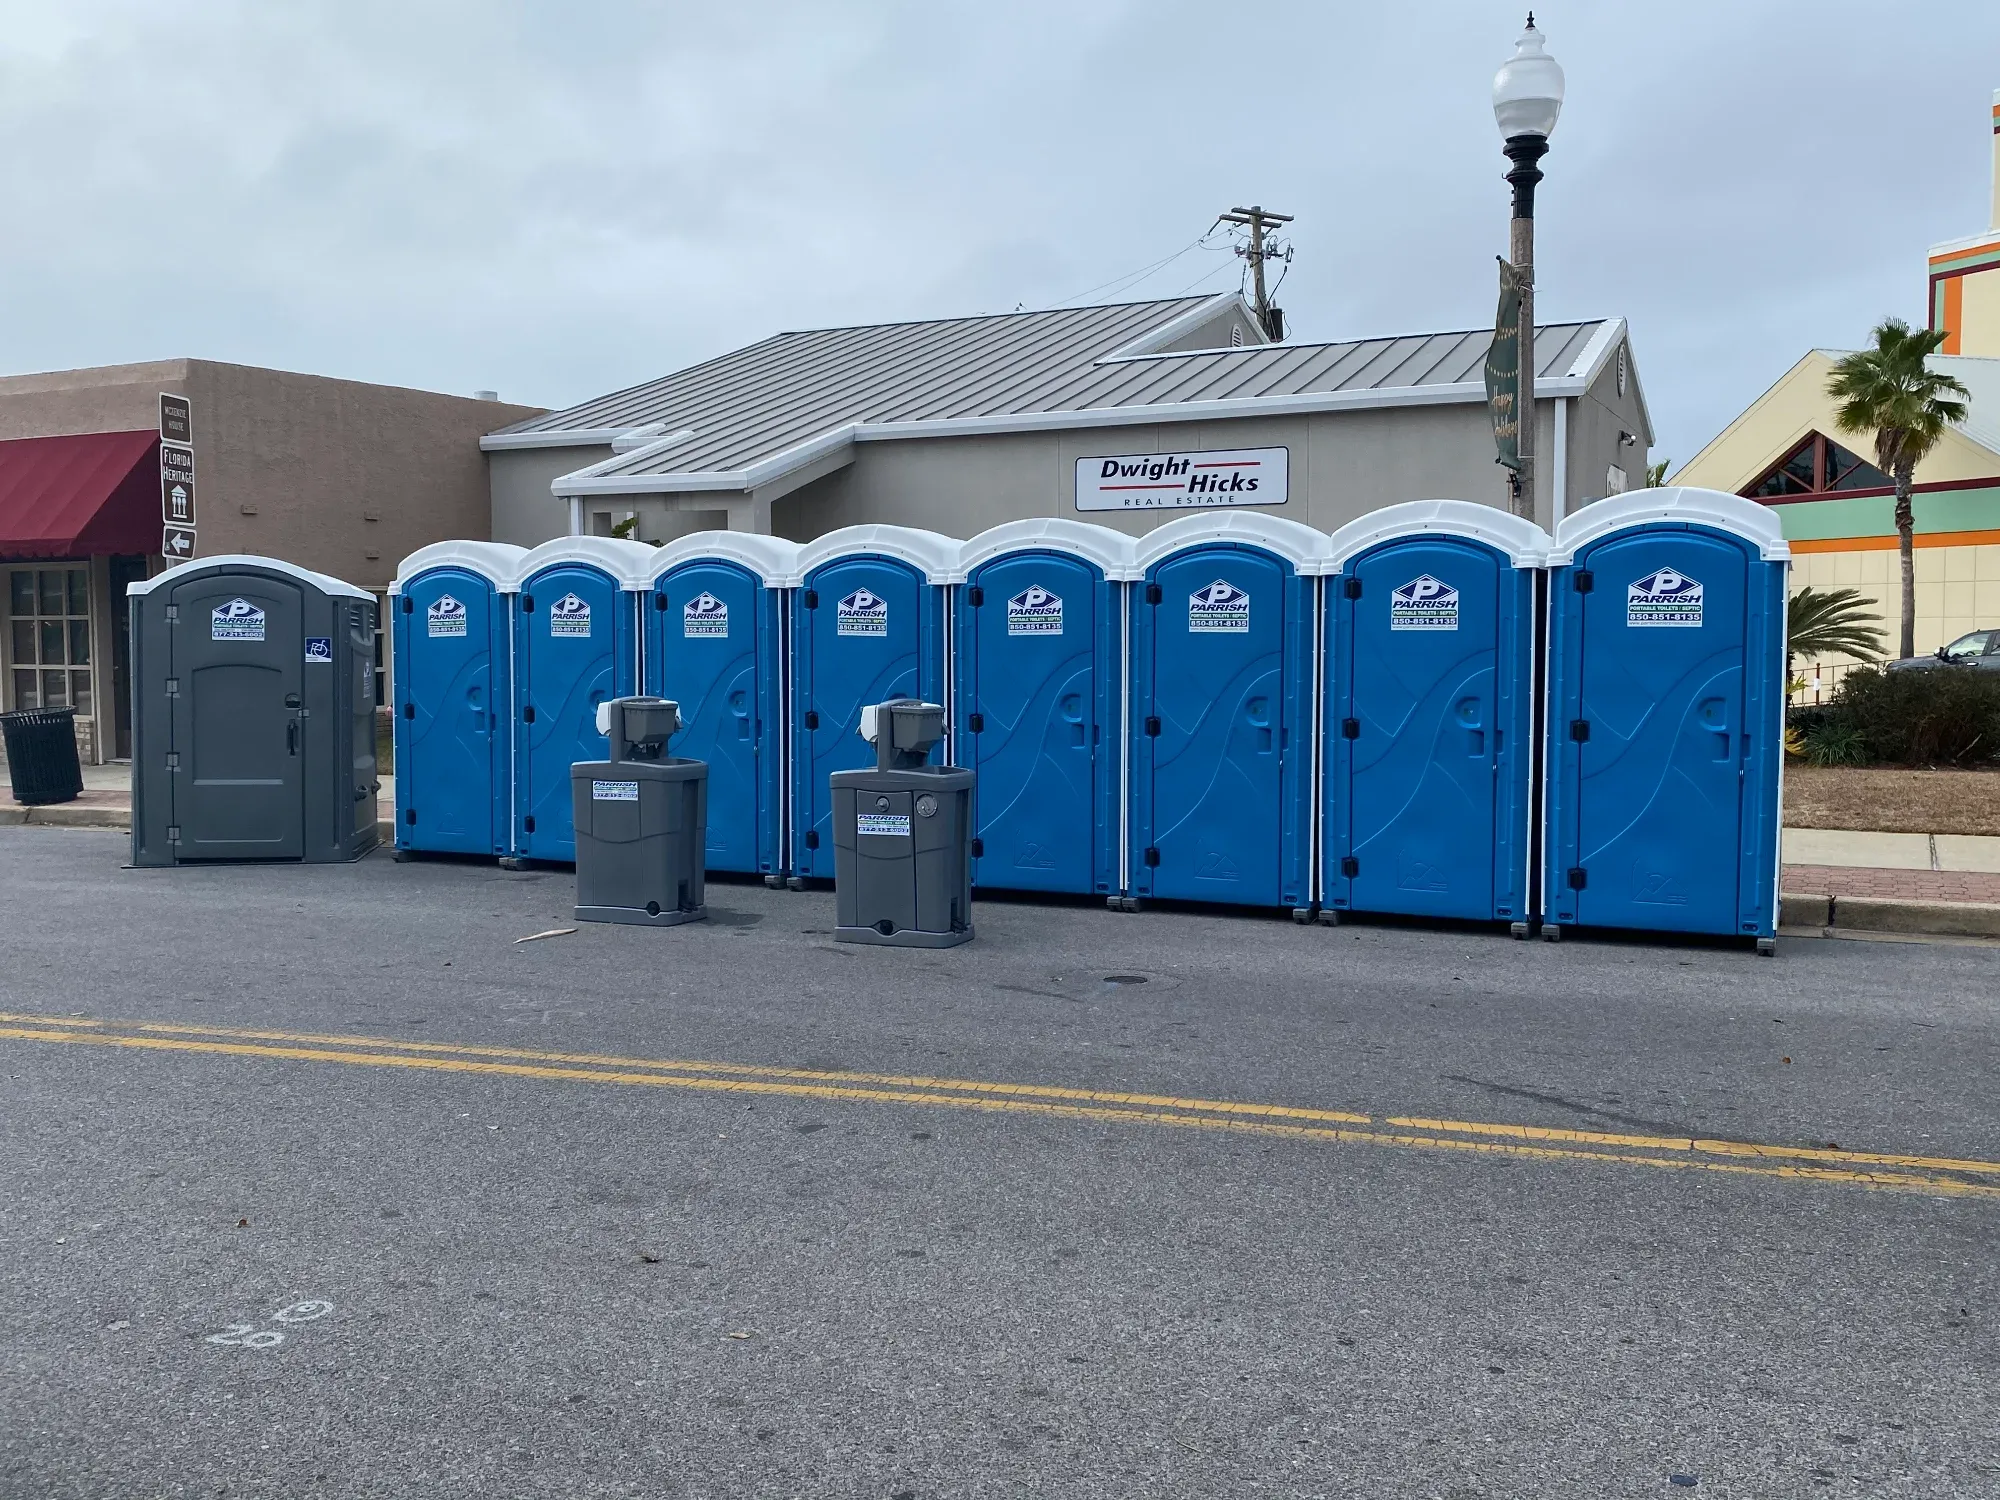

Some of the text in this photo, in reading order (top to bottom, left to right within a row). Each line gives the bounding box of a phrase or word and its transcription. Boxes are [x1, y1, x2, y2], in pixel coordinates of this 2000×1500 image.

[168, 420, 185, 432] HOUSE
[163, 449, 191, 467] FLORIDA
[162, 465, 193, 484] HERITAGE
[1101, 456, 1191, 480] Dwight
[1187, 472, 1259, 493] Hicks
[1124, 495, 1235, 506] REAL ESTATE
[1412, 580, 1439, 600] P
[1650, 573, 1682, 594] P
[852, 592, 873, 610] P
[1024, 589, 1047, 608] P
[1207, 584, 1232, 603] P
[1629, 595, 1702, 603] PARRISH
[227, 602, 250, 617] P
[439, 598, 455, 613] P
[562, 597, 580, 613] P
[697, 596, 715, 612] P
[1009, 608, 1062, 616] PARRISH
